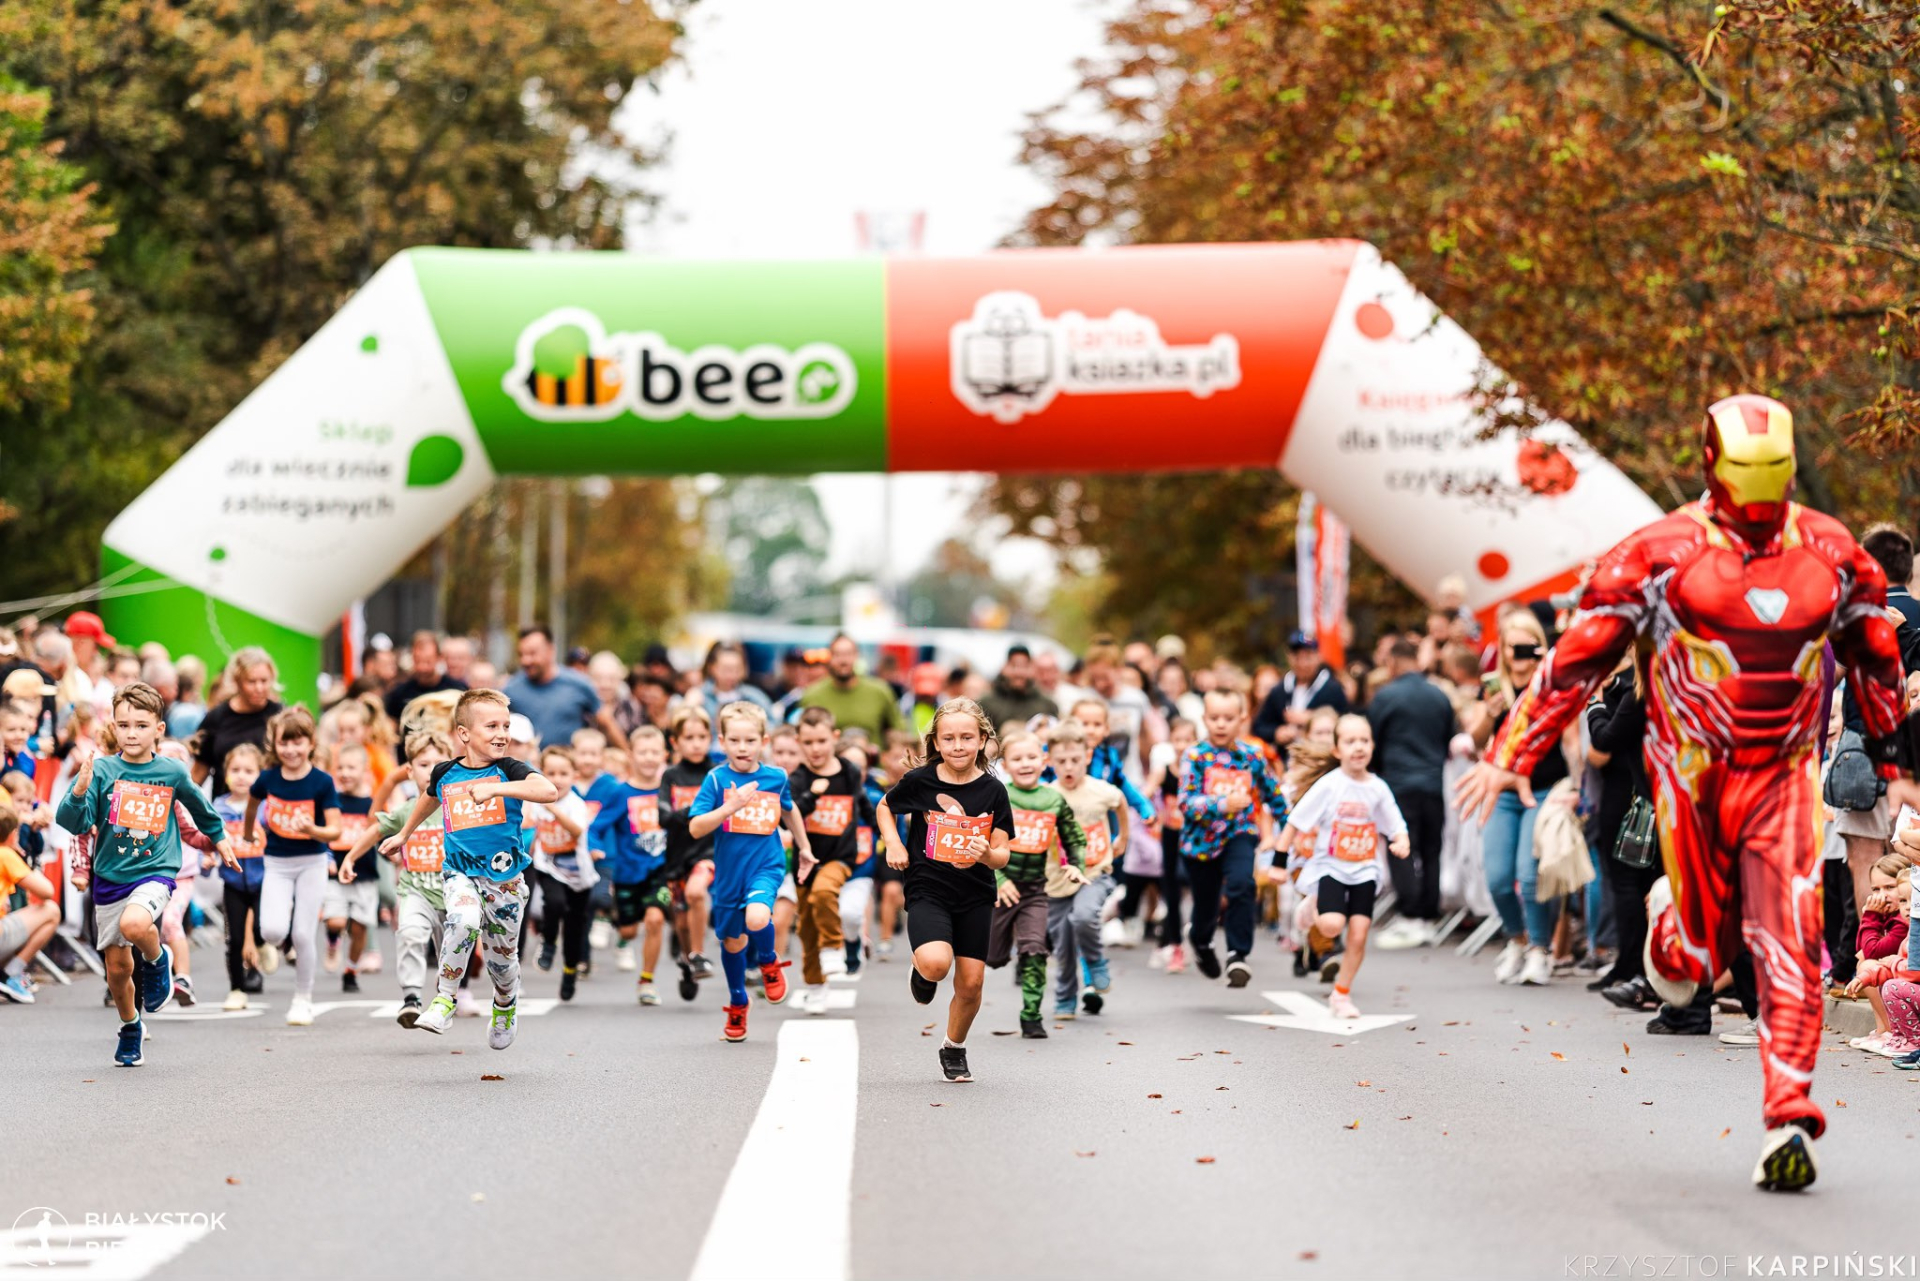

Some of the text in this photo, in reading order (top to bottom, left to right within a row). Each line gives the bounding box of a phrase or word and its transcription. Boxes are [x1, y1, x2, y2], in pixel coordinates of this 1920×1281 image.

[642, 348, 784, 405] bee
[1338, 425, 1380, 452] dla
[124, 799, 166, 818] 4219
[735, 806, 775, 823] 4234
